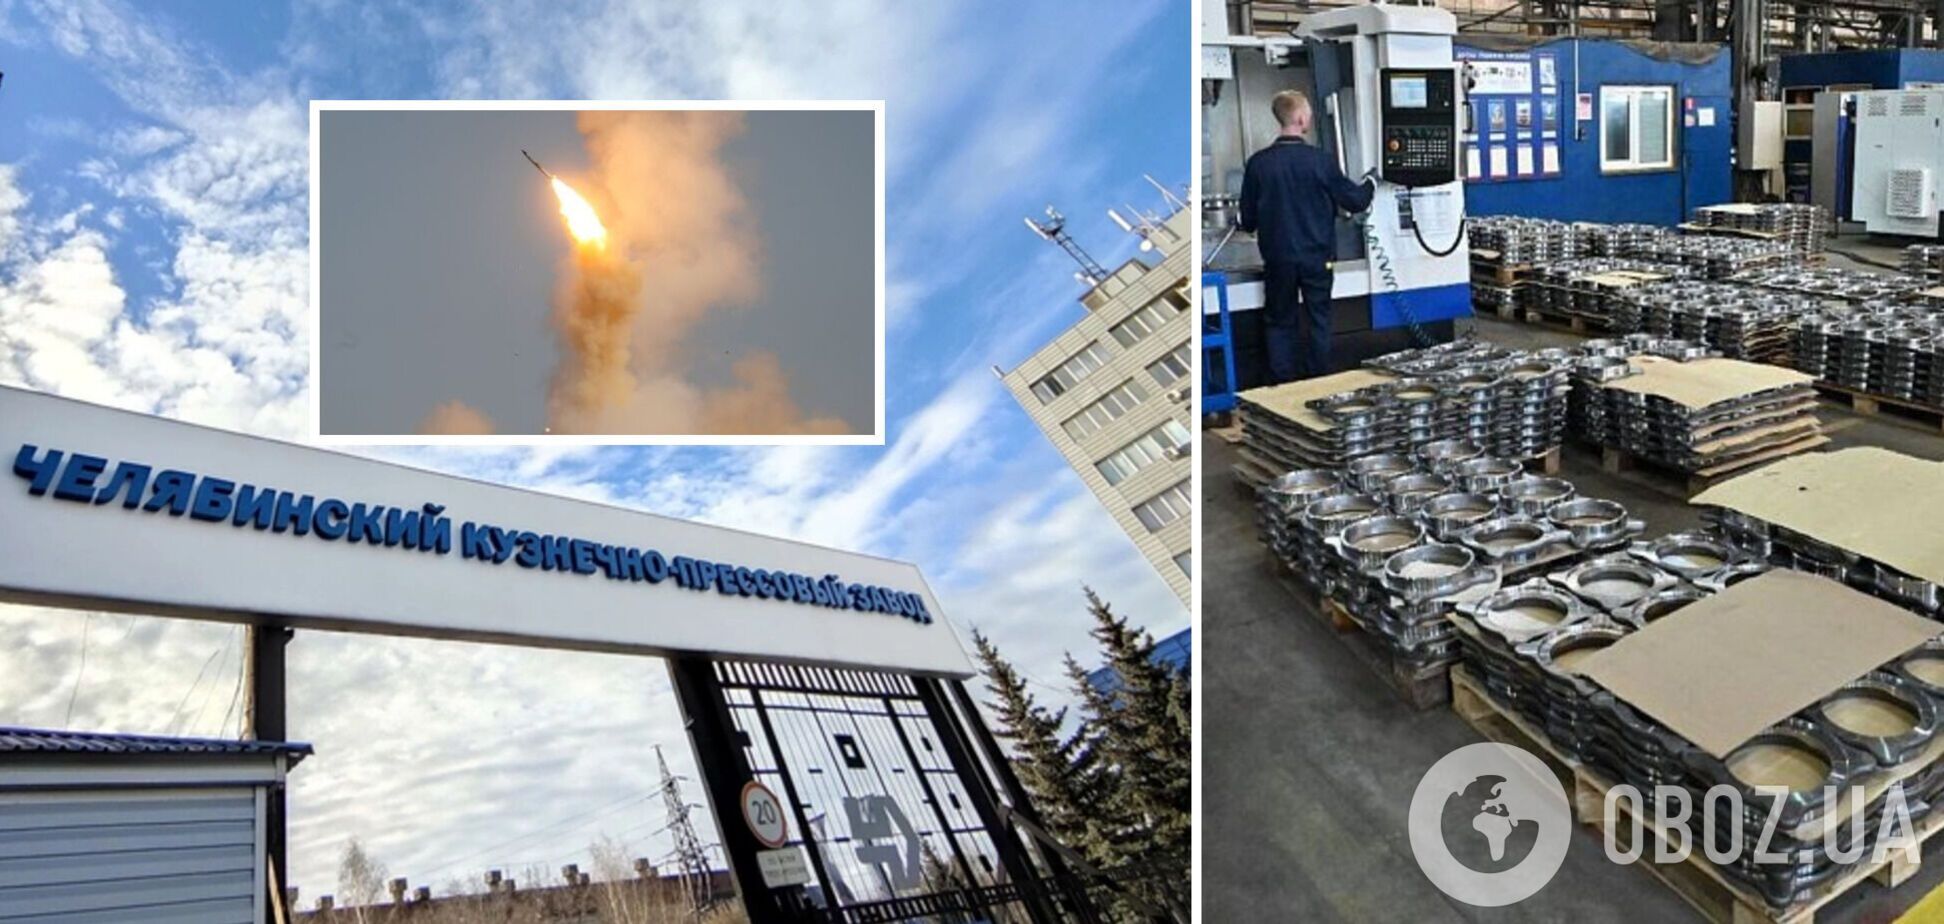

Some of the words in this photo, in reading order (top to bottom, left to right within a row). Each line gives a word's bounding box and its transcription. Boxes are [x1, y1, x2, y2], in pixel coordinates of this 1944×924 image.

[13, 444, 451, 555] ЧЕЛЯБИНСКИЙ
[461, 521, 850, 609] КУЗНЕЧНО-ПРЕССОВЫЙ
[848, 583, 933, 624] ЗАВОД
[752, 800, 776, 825] 20
